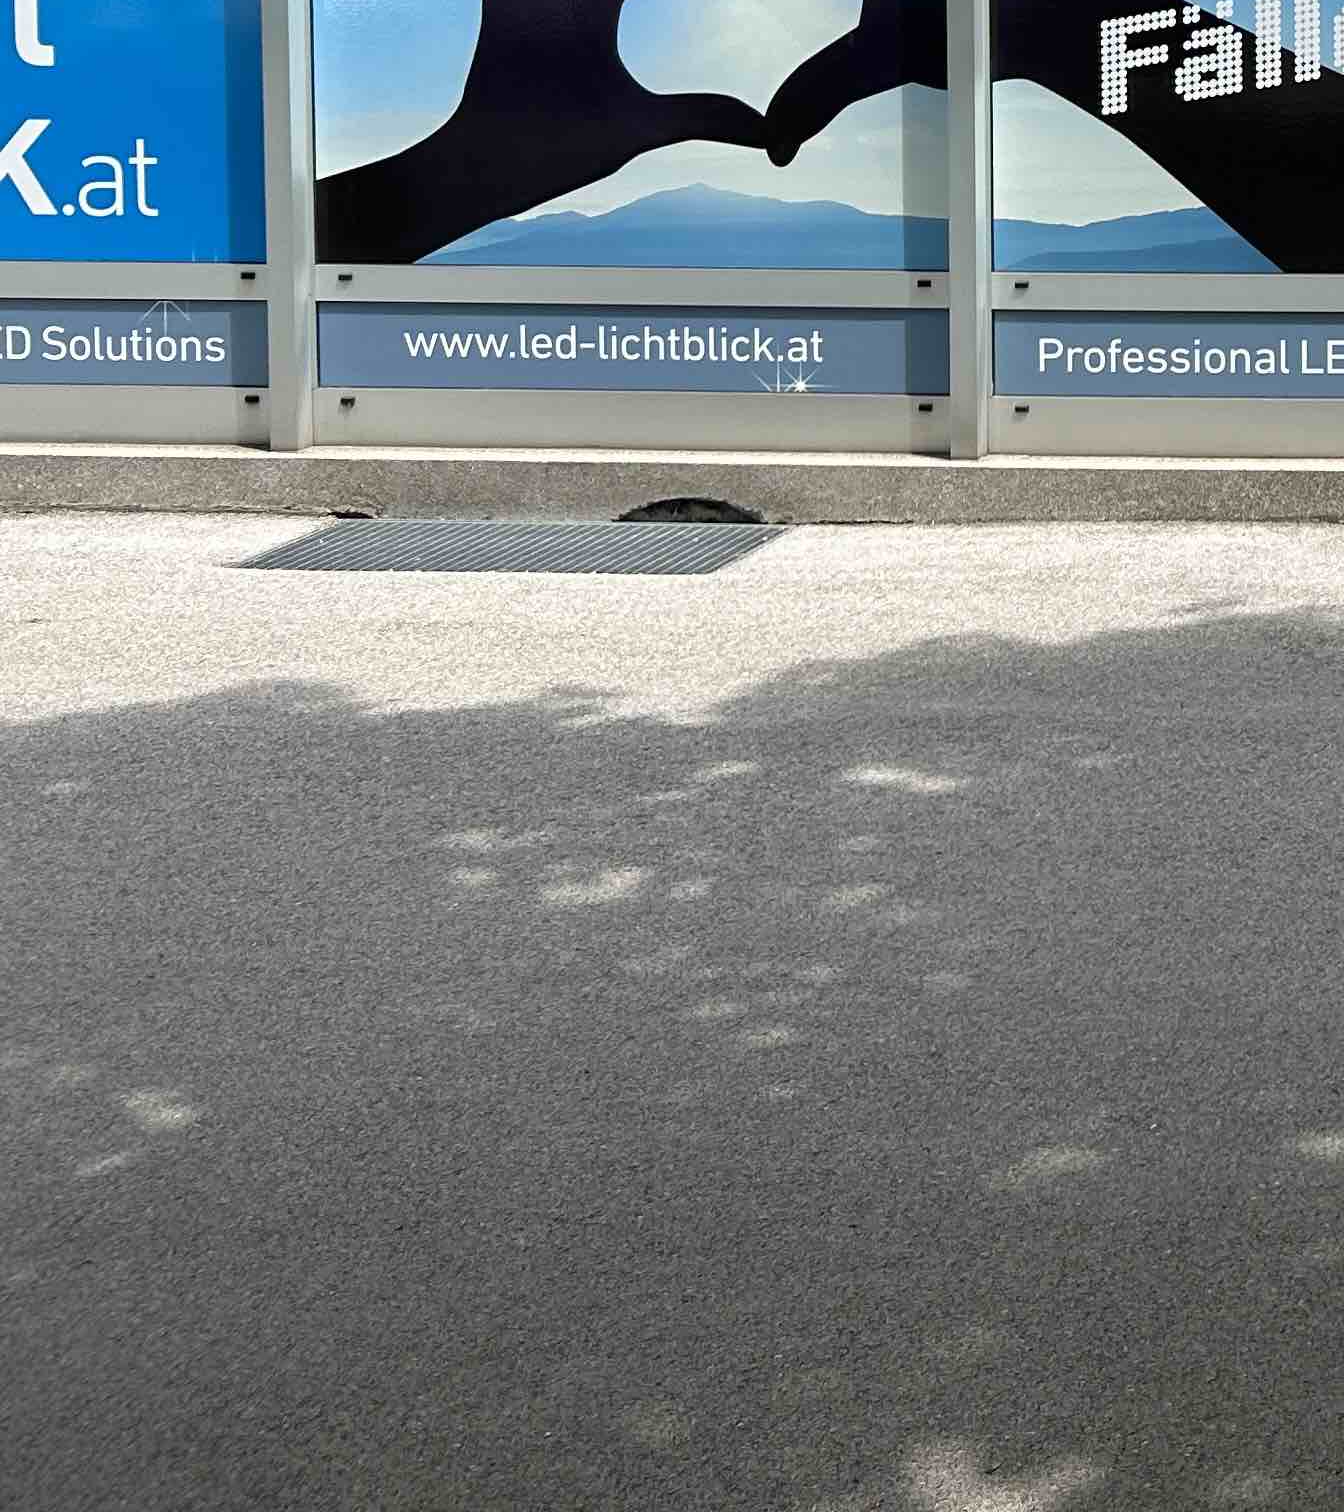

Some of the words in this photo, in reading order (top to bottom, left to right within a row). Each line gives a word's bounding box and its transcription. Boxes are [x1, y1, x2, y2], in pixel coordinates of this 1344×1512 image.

[42, 325, 226, 363] Solutions
[404, 323, 823, 364] www.led-lichtblick.at
[1038, 338, 1289, 375] Professional
